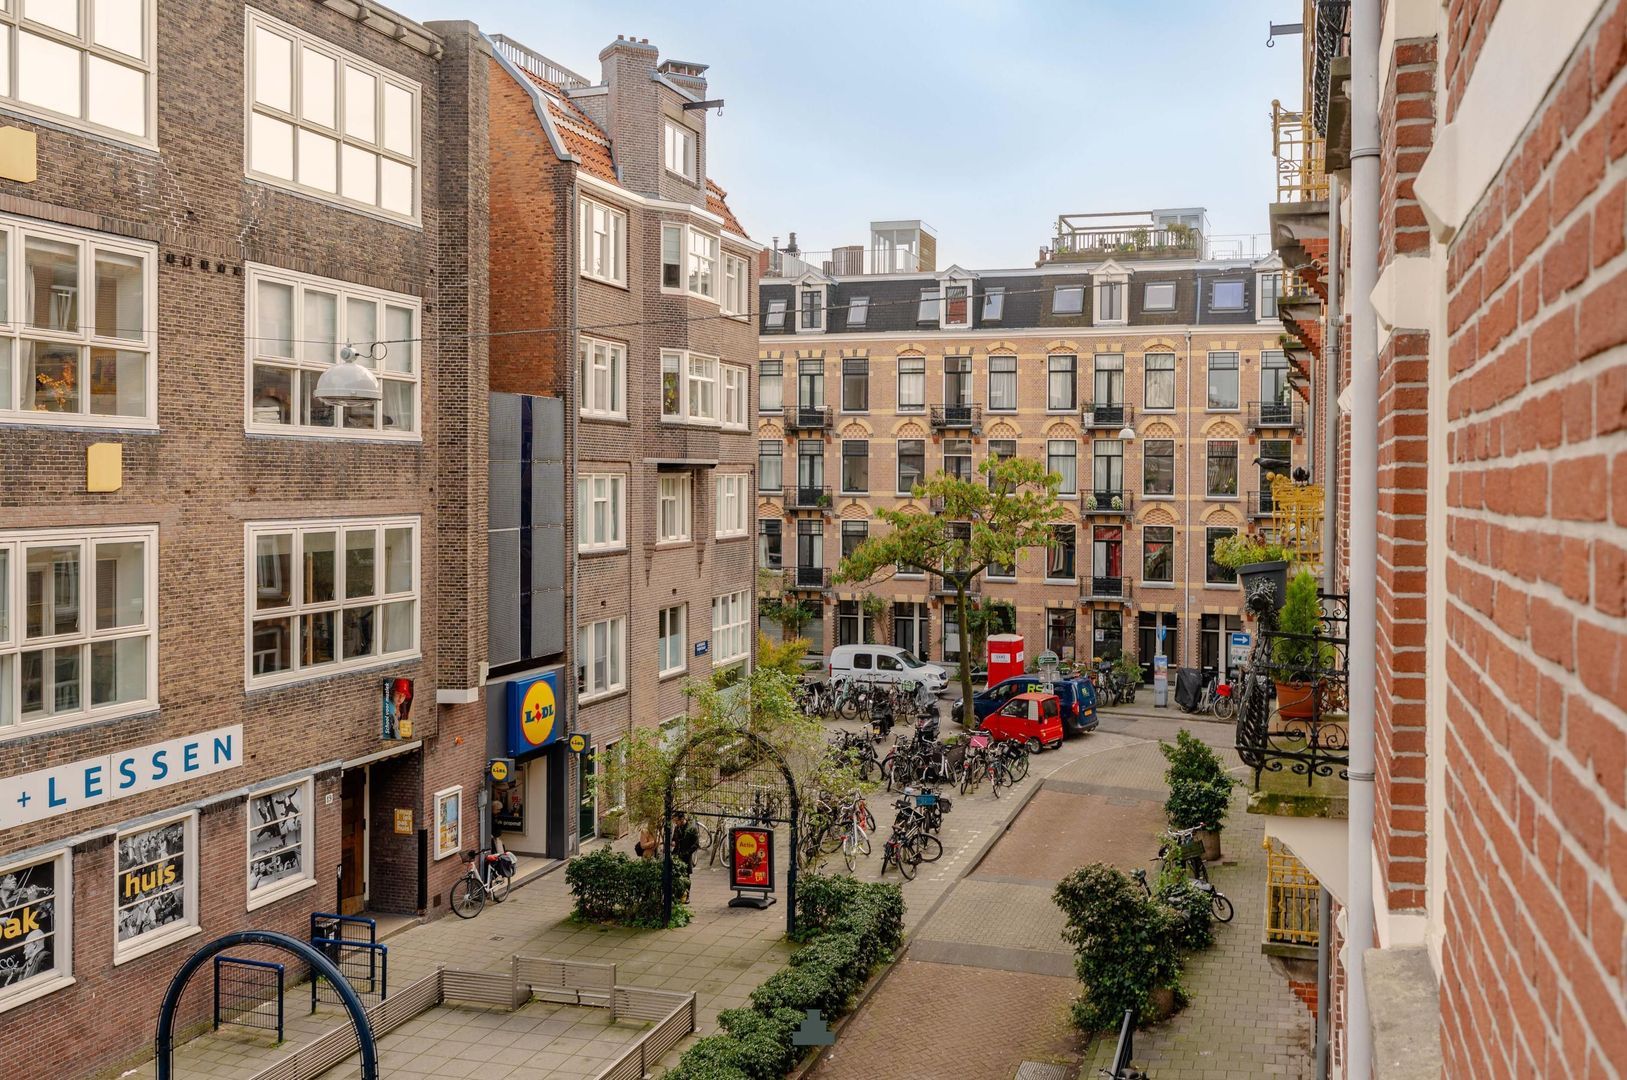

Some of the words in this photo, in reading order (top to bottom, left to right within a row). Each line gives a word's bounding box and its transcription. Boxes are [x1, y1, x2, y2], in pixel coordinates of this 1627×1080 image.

[48, 734, 232, 808] LESSEN
[125, 862, 176, 897] huis
[0, 907, 39, 939] ak
